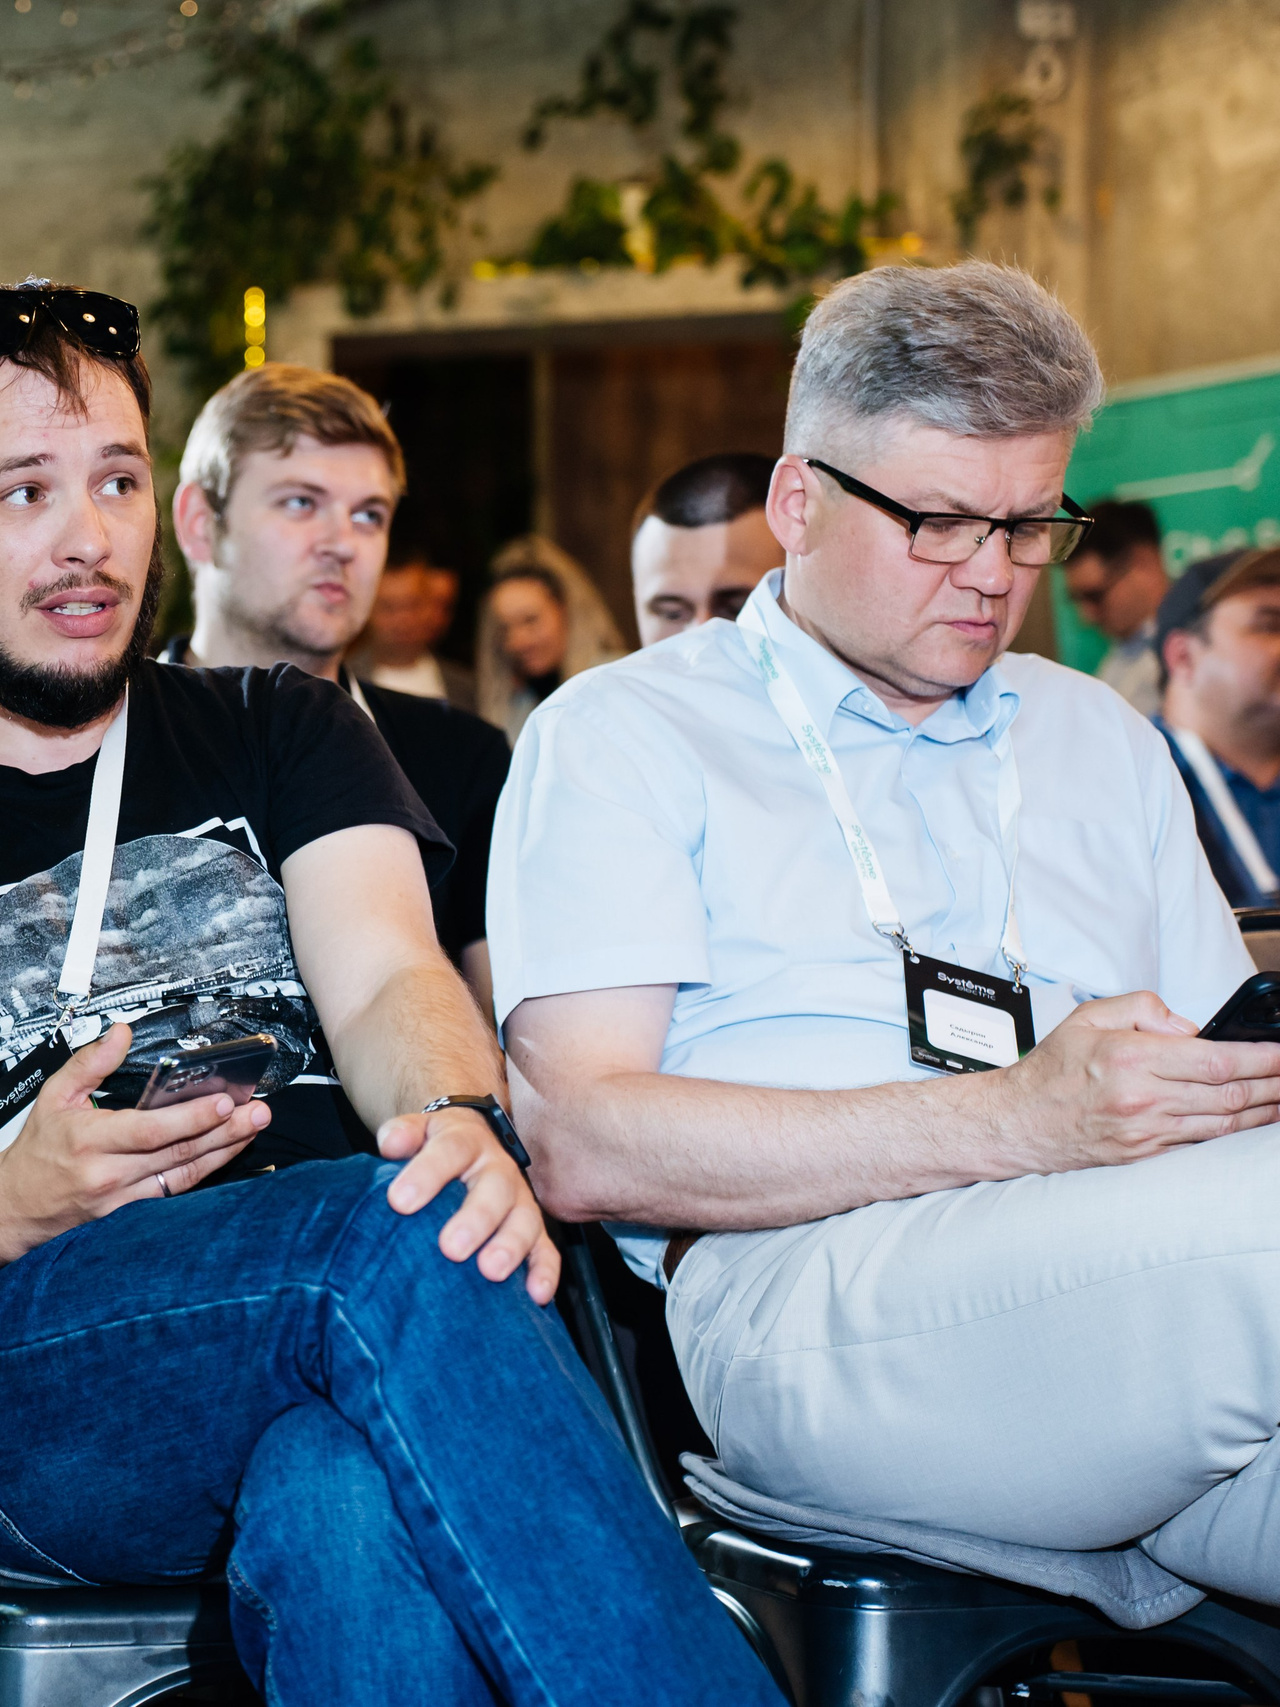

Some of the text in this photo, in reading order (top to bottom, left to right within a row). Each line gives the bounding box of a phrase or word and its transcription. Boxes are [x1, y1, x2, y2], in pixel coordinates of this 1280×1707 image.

[801, 723, 832, 776] Systême
[851, 823, 877, 880] Systême
[937, 971, 996, 996] Systême
[950, 1032, 994, 1049] Александр
[13, 1073, 45, 1104] electric
